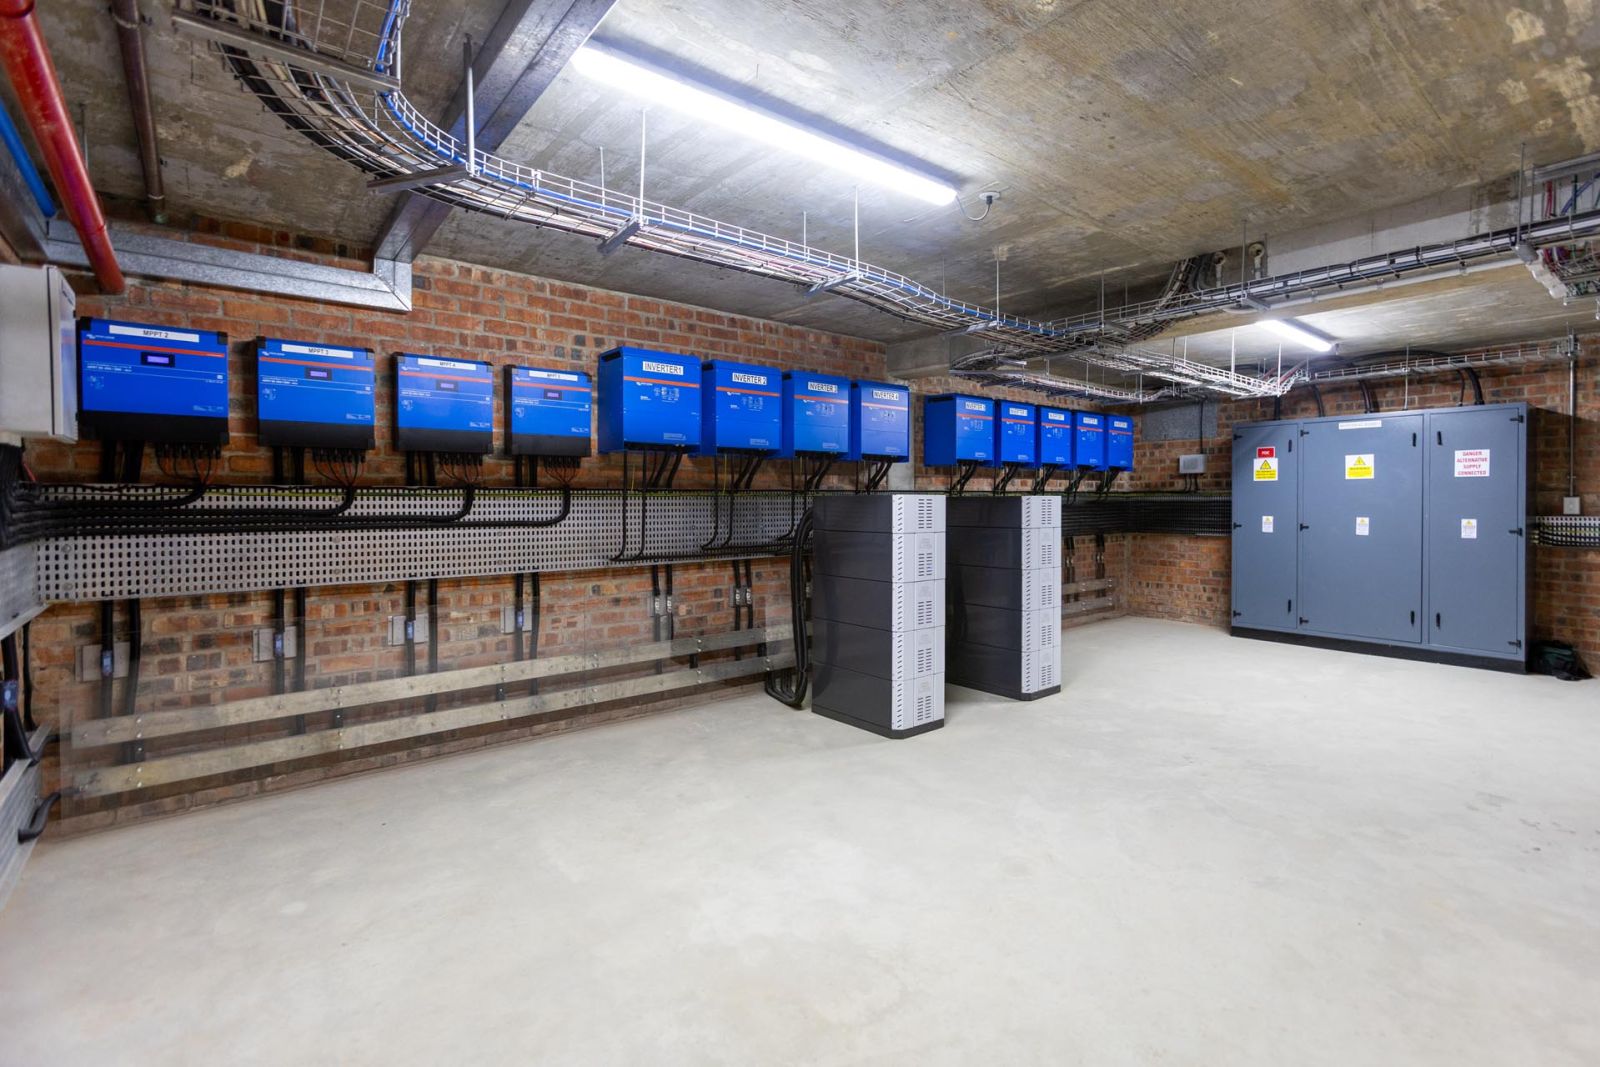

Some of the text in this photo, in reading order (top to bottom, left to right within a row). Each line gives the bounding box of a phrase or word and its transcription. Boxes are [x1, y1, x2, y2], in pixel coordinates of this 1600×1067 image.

[143, 330, 162, 338] MPPT
[734, 374, 762, 384] INVERTER
[809, 383, 833, 391] INVERTER
[874, 391, 895, 399] INVERTER
